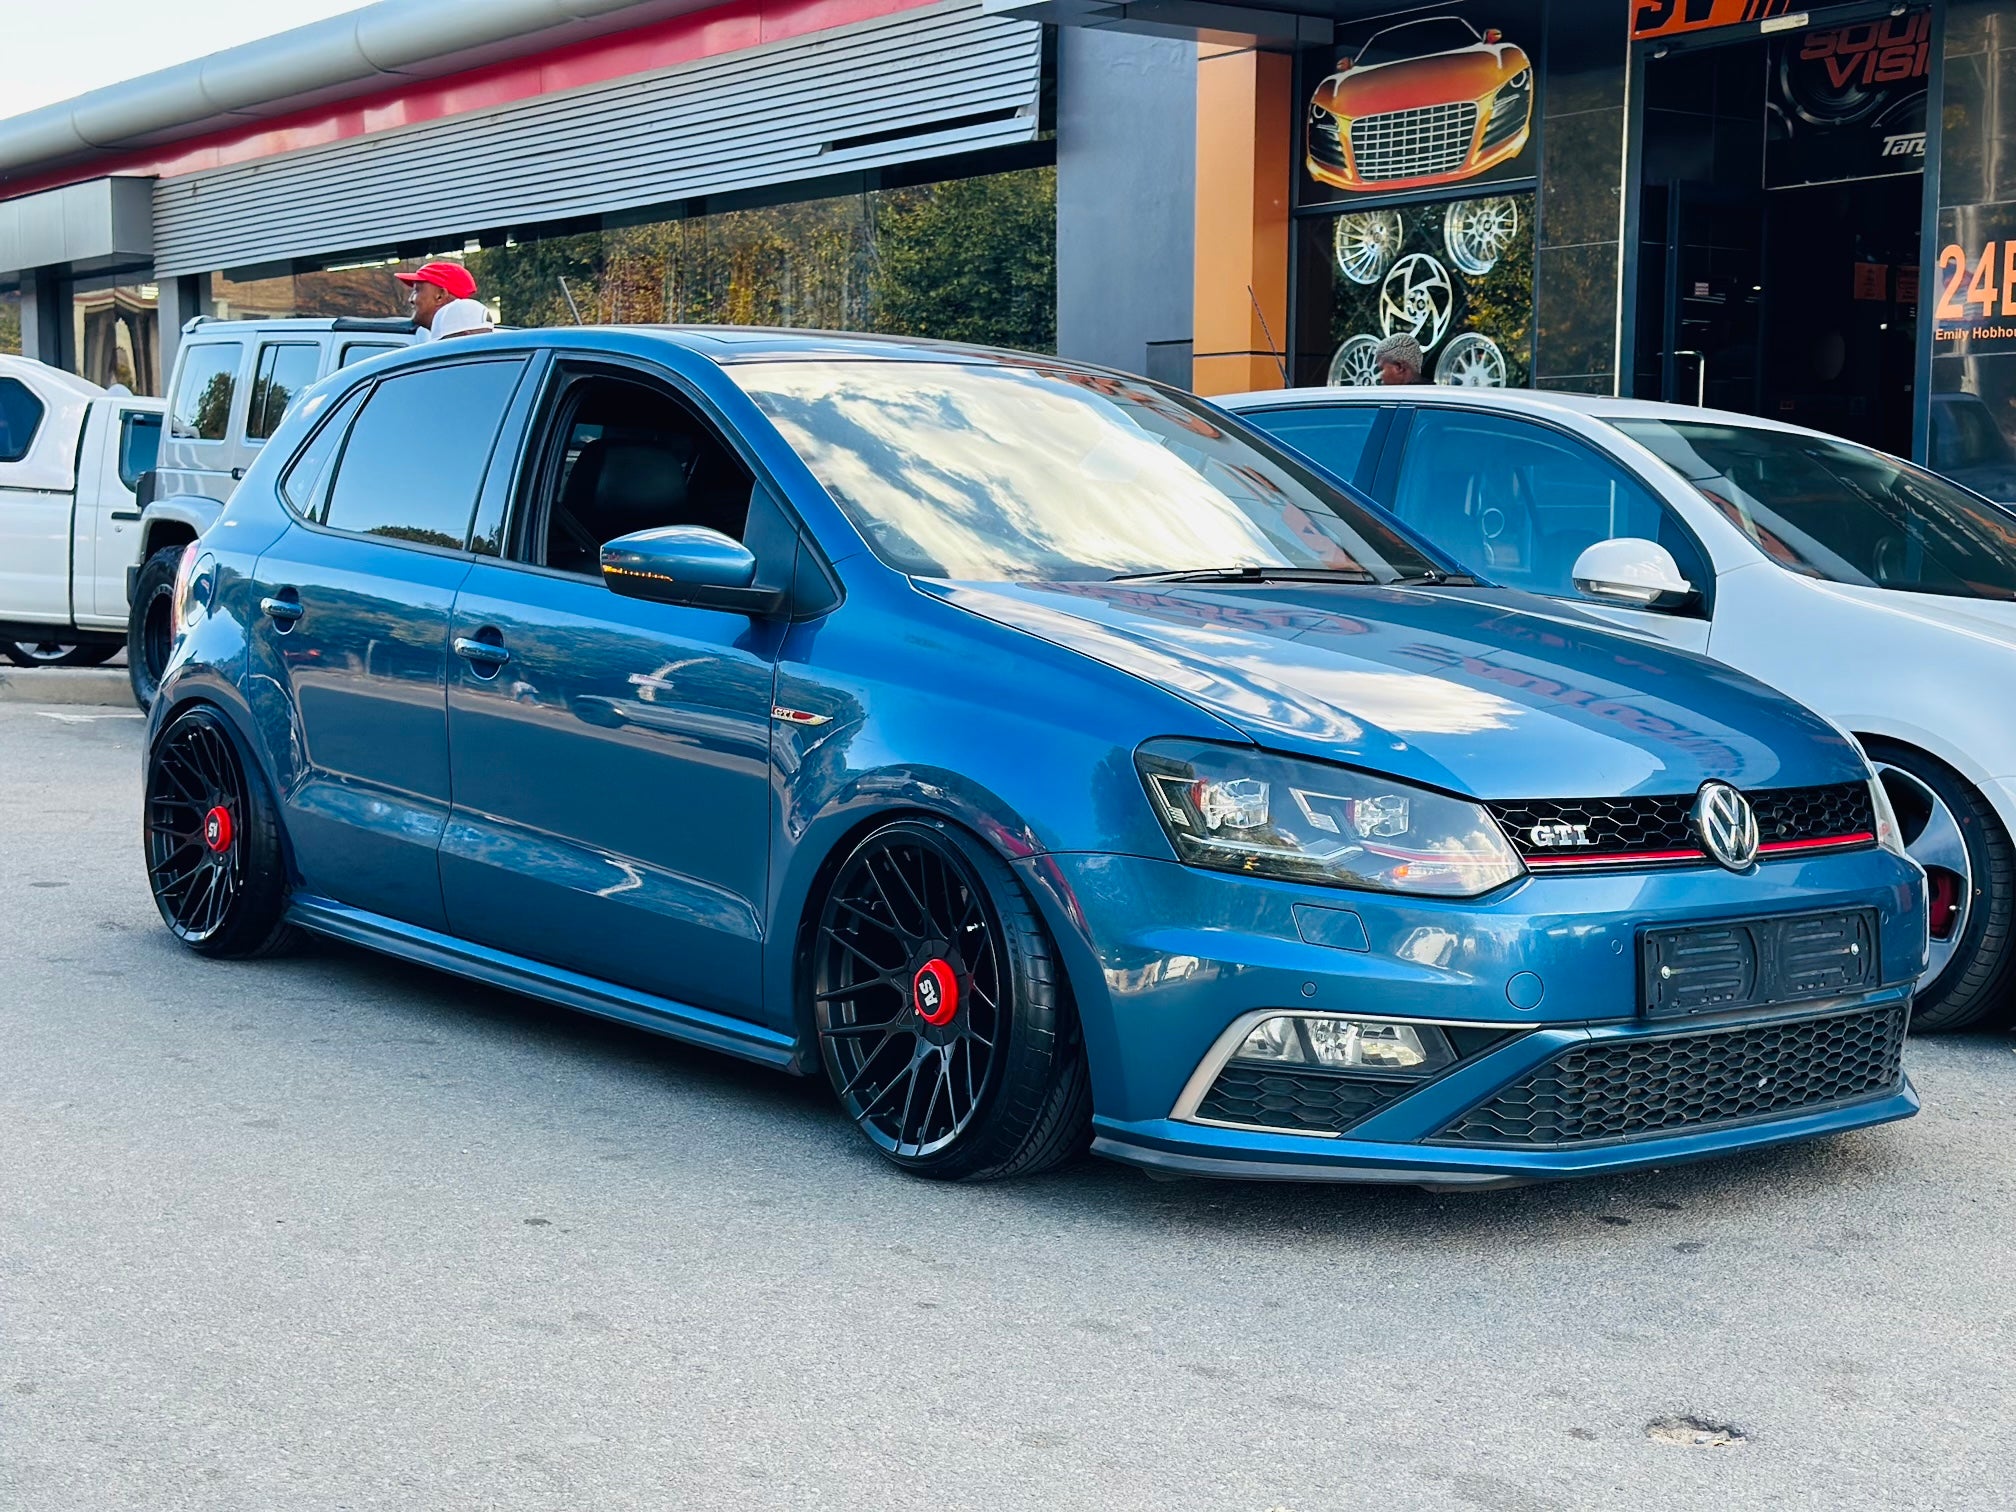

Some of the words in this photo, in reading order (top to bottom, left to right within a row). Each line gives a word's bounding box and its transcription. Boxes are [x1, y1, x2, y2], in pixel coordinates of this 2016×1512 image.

[1823, 42, 1931, 88] VISI
[1935, 327, 1969, 341] Emily
[1972, 325, 2016, 339] Hobho
[774, 707, 796, 721] GTI
[1530, 824, 1590, 847] GTI
